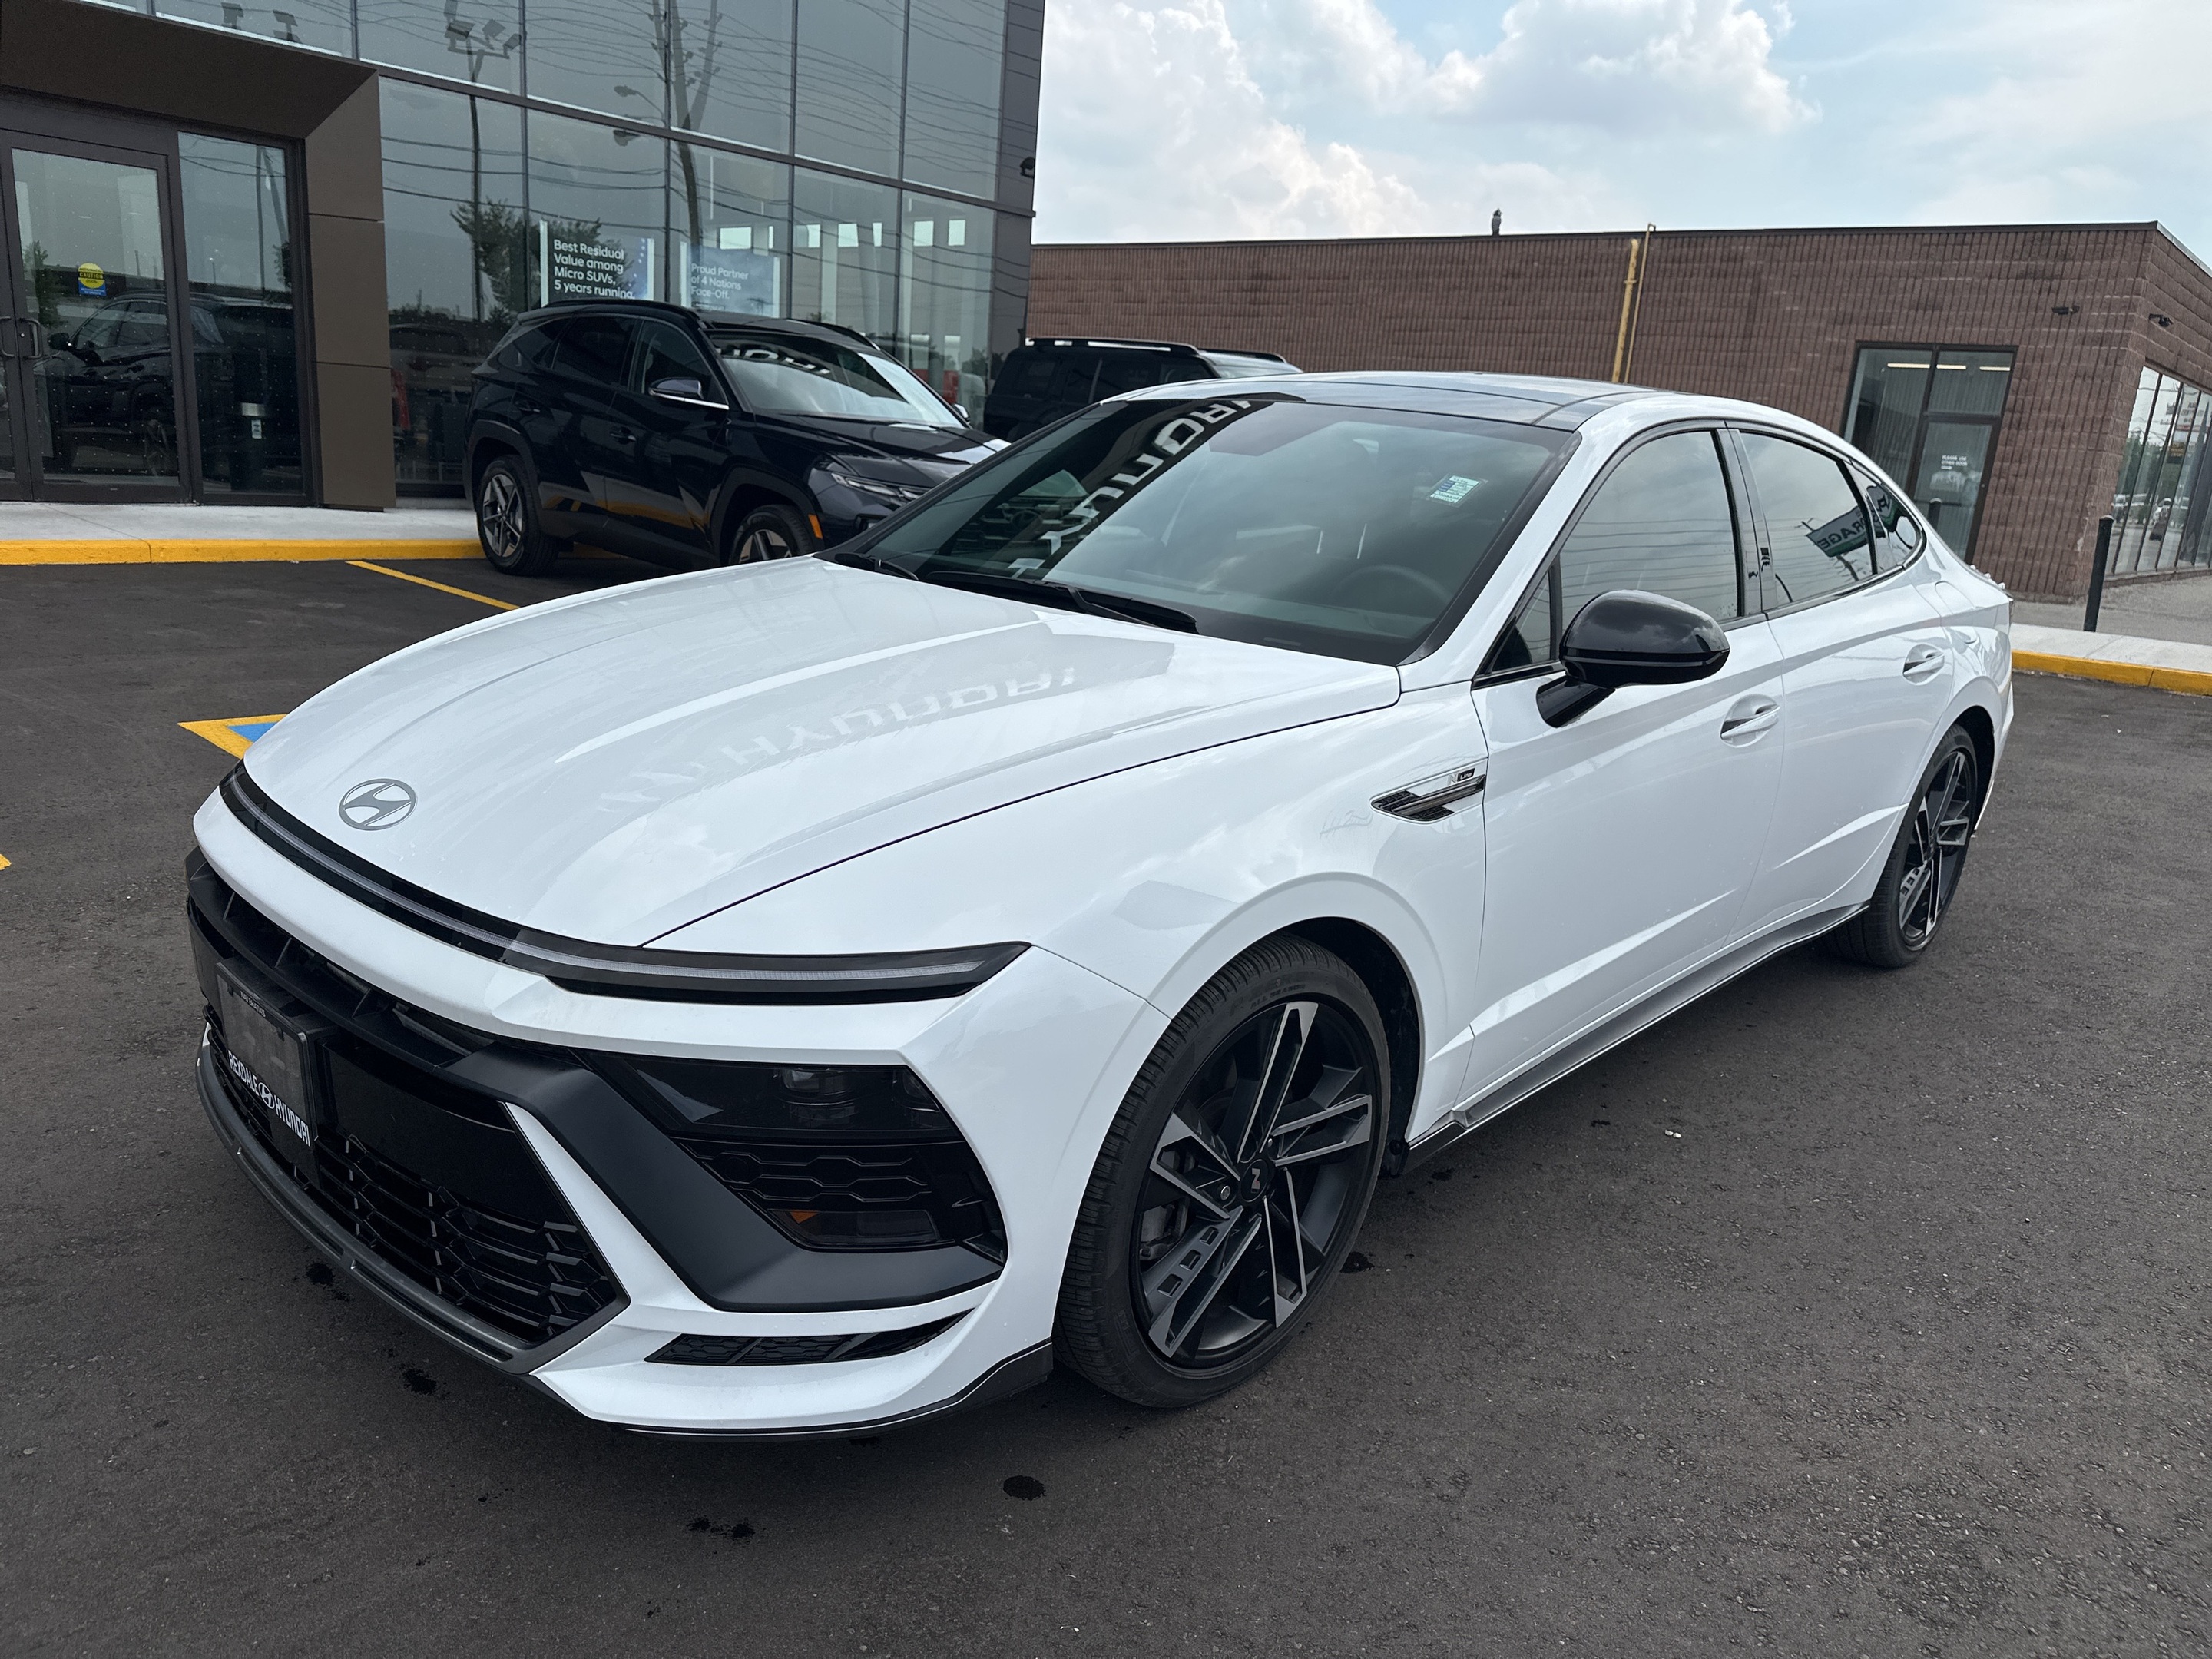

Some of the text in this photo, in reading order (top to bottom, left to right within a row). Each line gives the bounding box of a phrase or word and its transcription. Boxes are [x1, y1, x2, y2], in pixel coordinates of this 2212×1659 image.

[553, 239, 624, 260] Best Residual
[553, 252, 624, 274] Value among
[691, 263, 749, 280] Proud Partner
[554, 266, 617, 286] Micro SUVs,
[690, 275, 742, 290] of 4 Nations
[554, 280, 636, 300] 5 years running.
[691, 286, 730, 300] Face-Off.
[228, 1049, 311, 1147] REXDALE HYUNDAI
